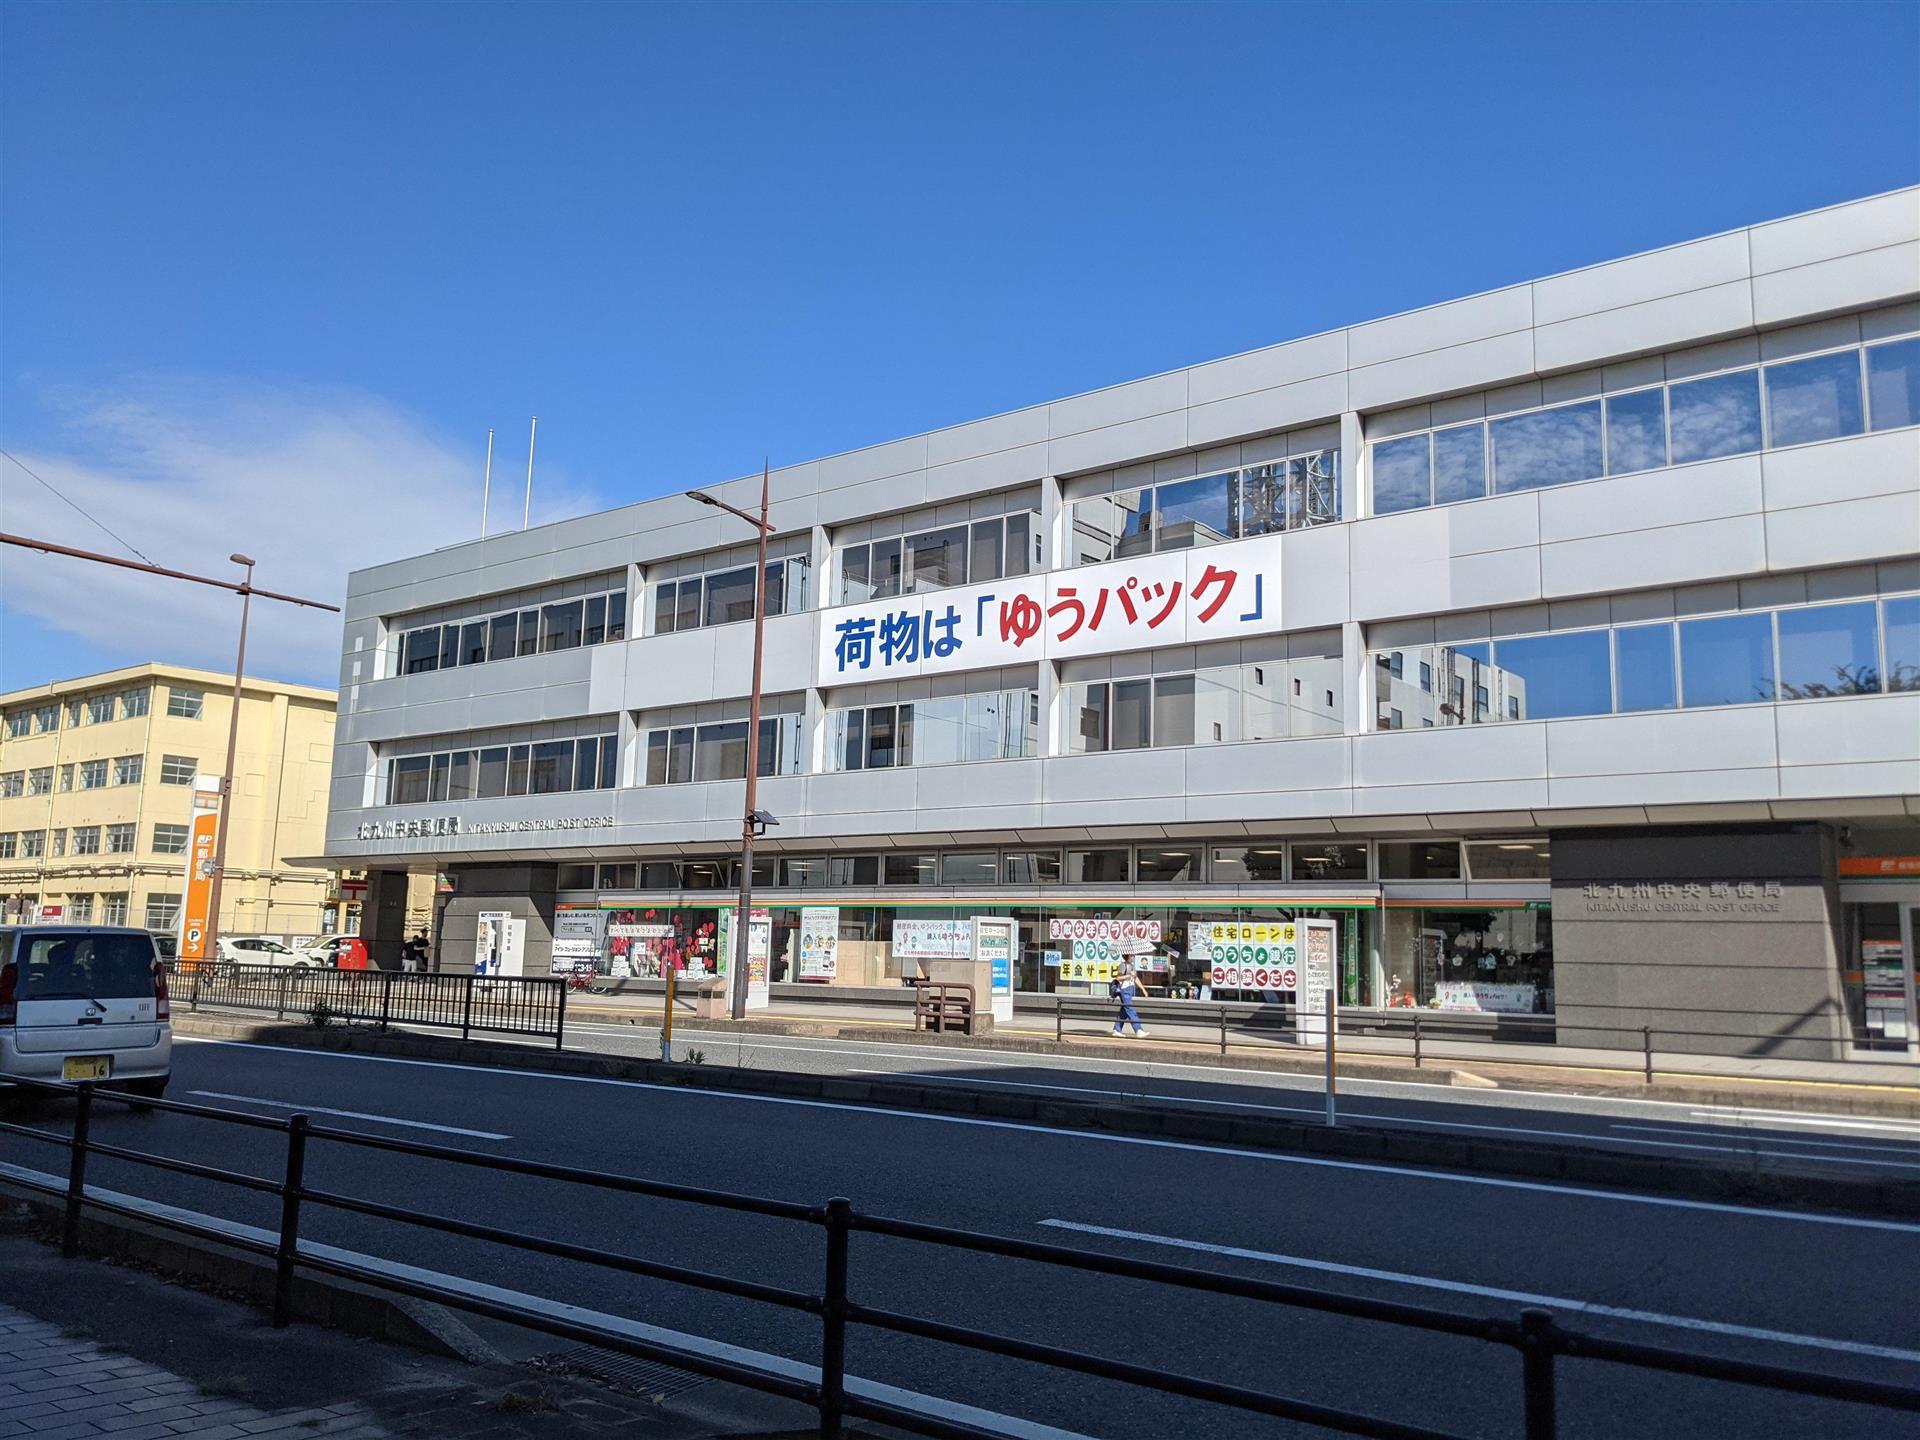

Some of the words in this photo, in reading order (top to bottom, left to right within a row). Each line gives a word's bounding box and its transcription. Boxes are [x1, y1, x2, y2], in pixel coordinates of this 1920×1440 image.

[835, 564, 1263, 672] 荷物は「ゆうパック」
[358, 816, 461, 840] 北九州中央郵便局
[468, 821, 517, 834] KITAKYUSHU
[519, 819, 555, 832] CENTRAL
[557, 818, 581, 829] POST
[583, 815, 615, 828] OFFICE
[1583, 881, 1784, 900] 北九州中央郵便局
[1586, 902, 1650, 913] KITAKYUSHU
[1654, 902, 1703, 913] CENTRAL
[1706, 902, 1735, 913] POST
[1739, 902, 1781, 913] OFFICE
[190, 930, 199, 941] P
[1051, 920, 1159, 940] 素敵な年金ライフは
[1213, 926, 1294, 940] 住宅ローンは
[1073, 942, 1121, 960] ゆうち
[1213, 947, 1295, 964] ゆうちょ銀行
